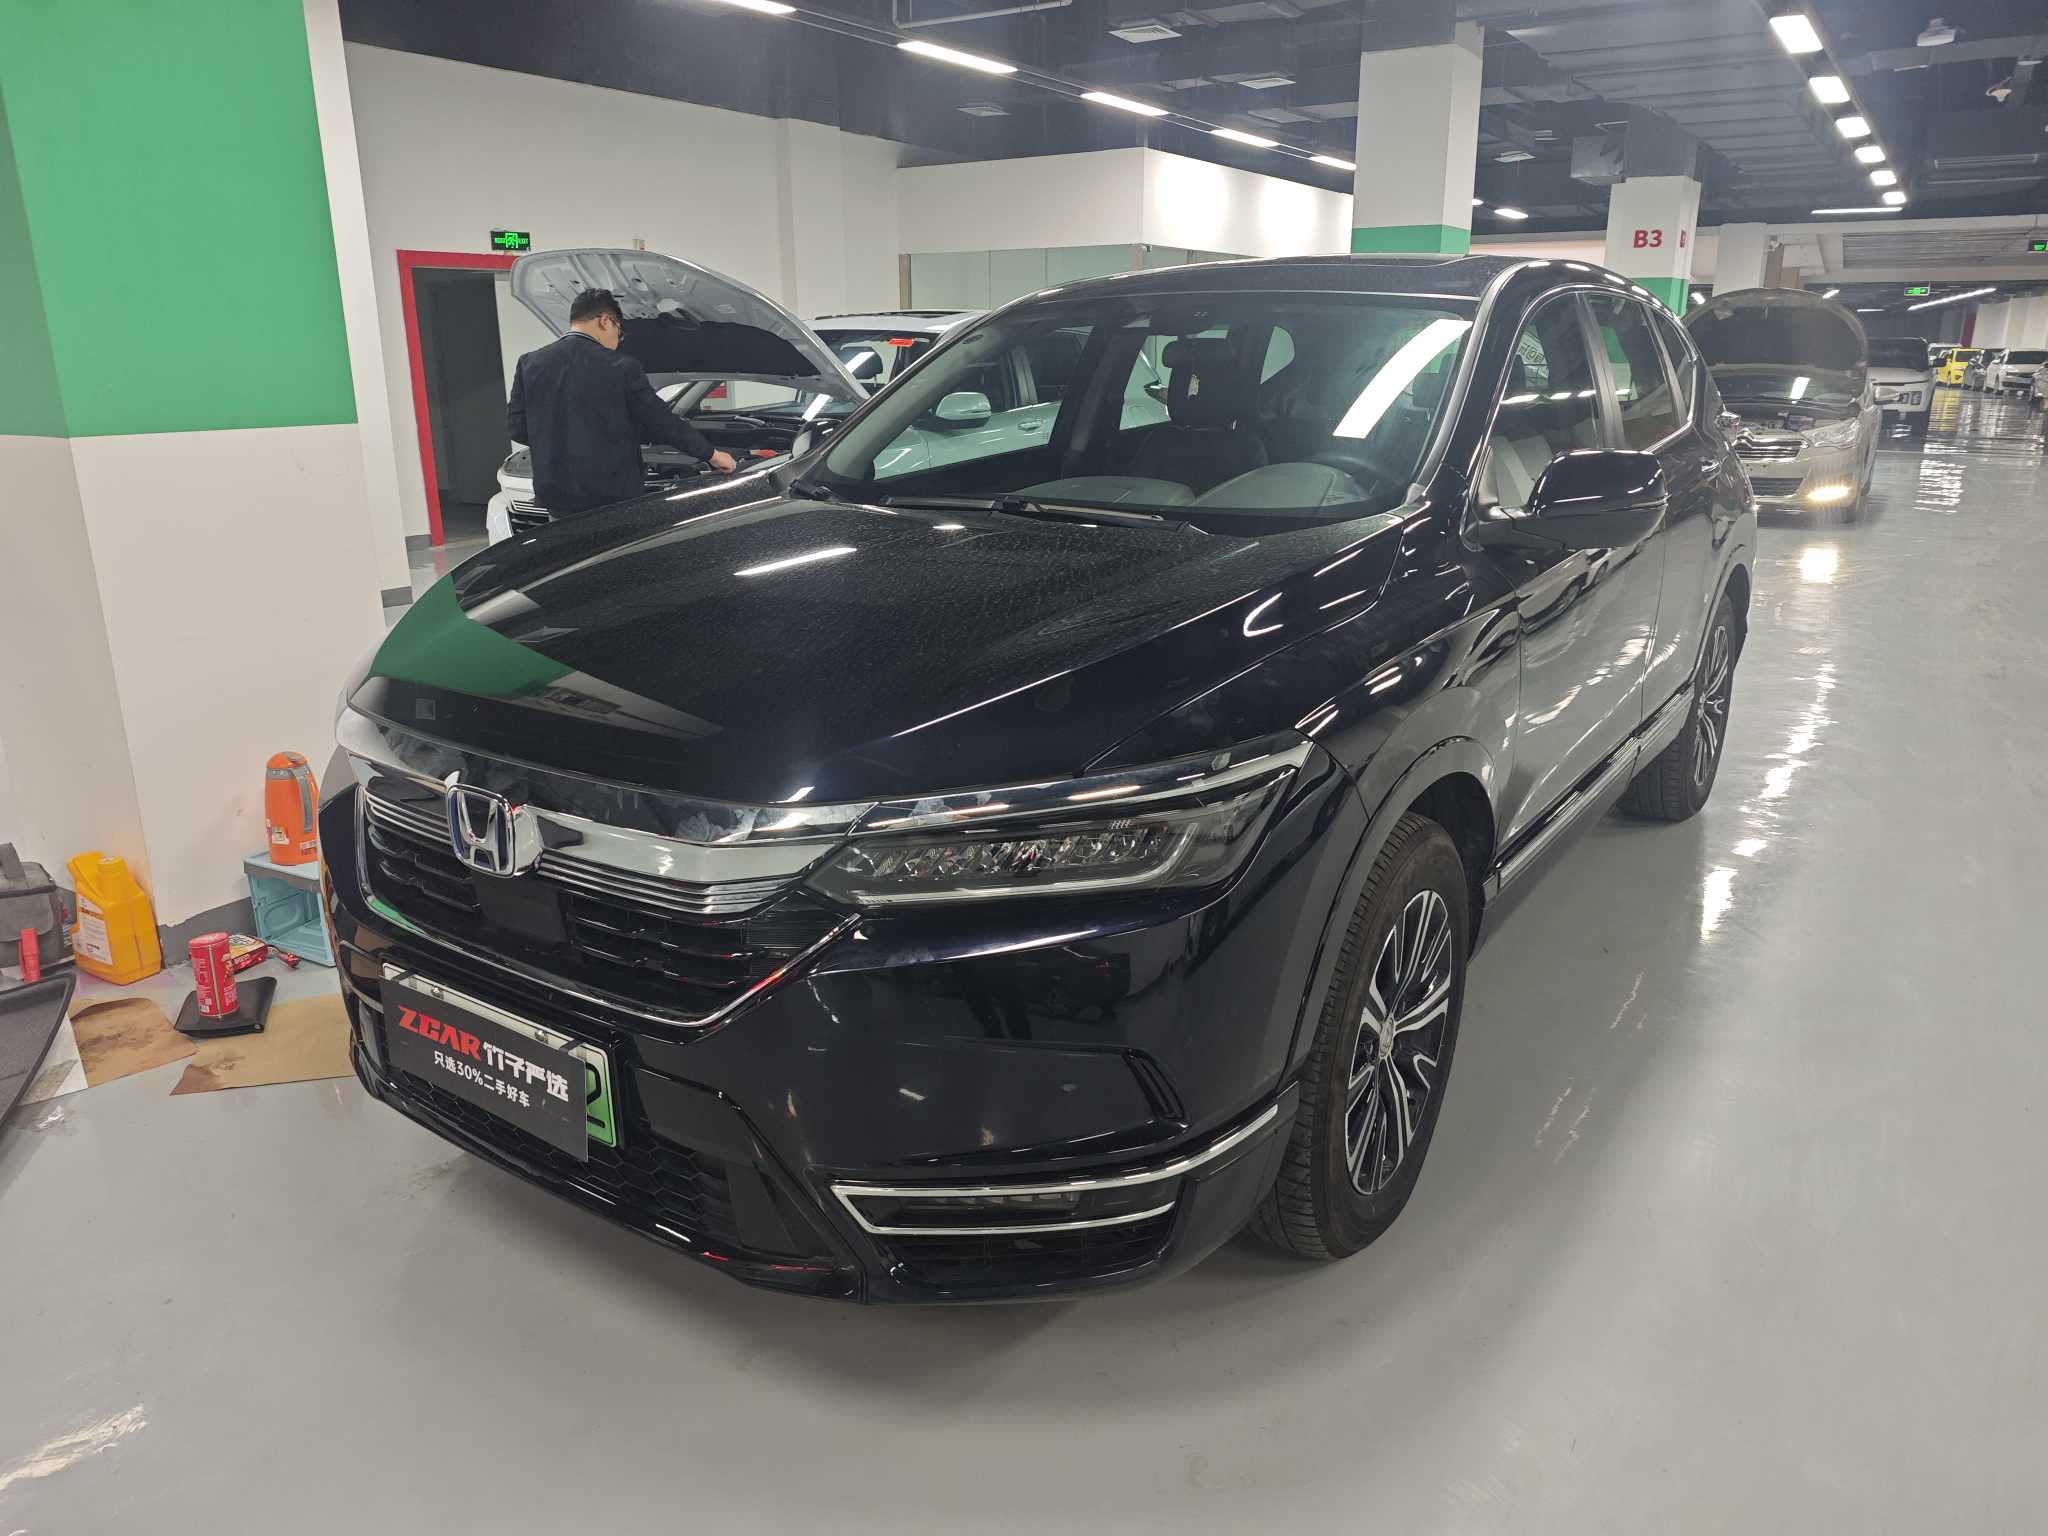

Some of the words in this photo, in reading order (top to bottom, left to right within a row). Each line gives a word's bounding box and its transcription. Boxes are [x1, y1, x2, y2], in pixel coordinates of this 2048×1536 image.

[1633, 229, 1663, 249] B3
[399, 1005, 481, 1061] ZCAR
[483, 1041, 569, 1102] 竹子严选
[433, 1050, 531, 1108] 只选30%二手好车
